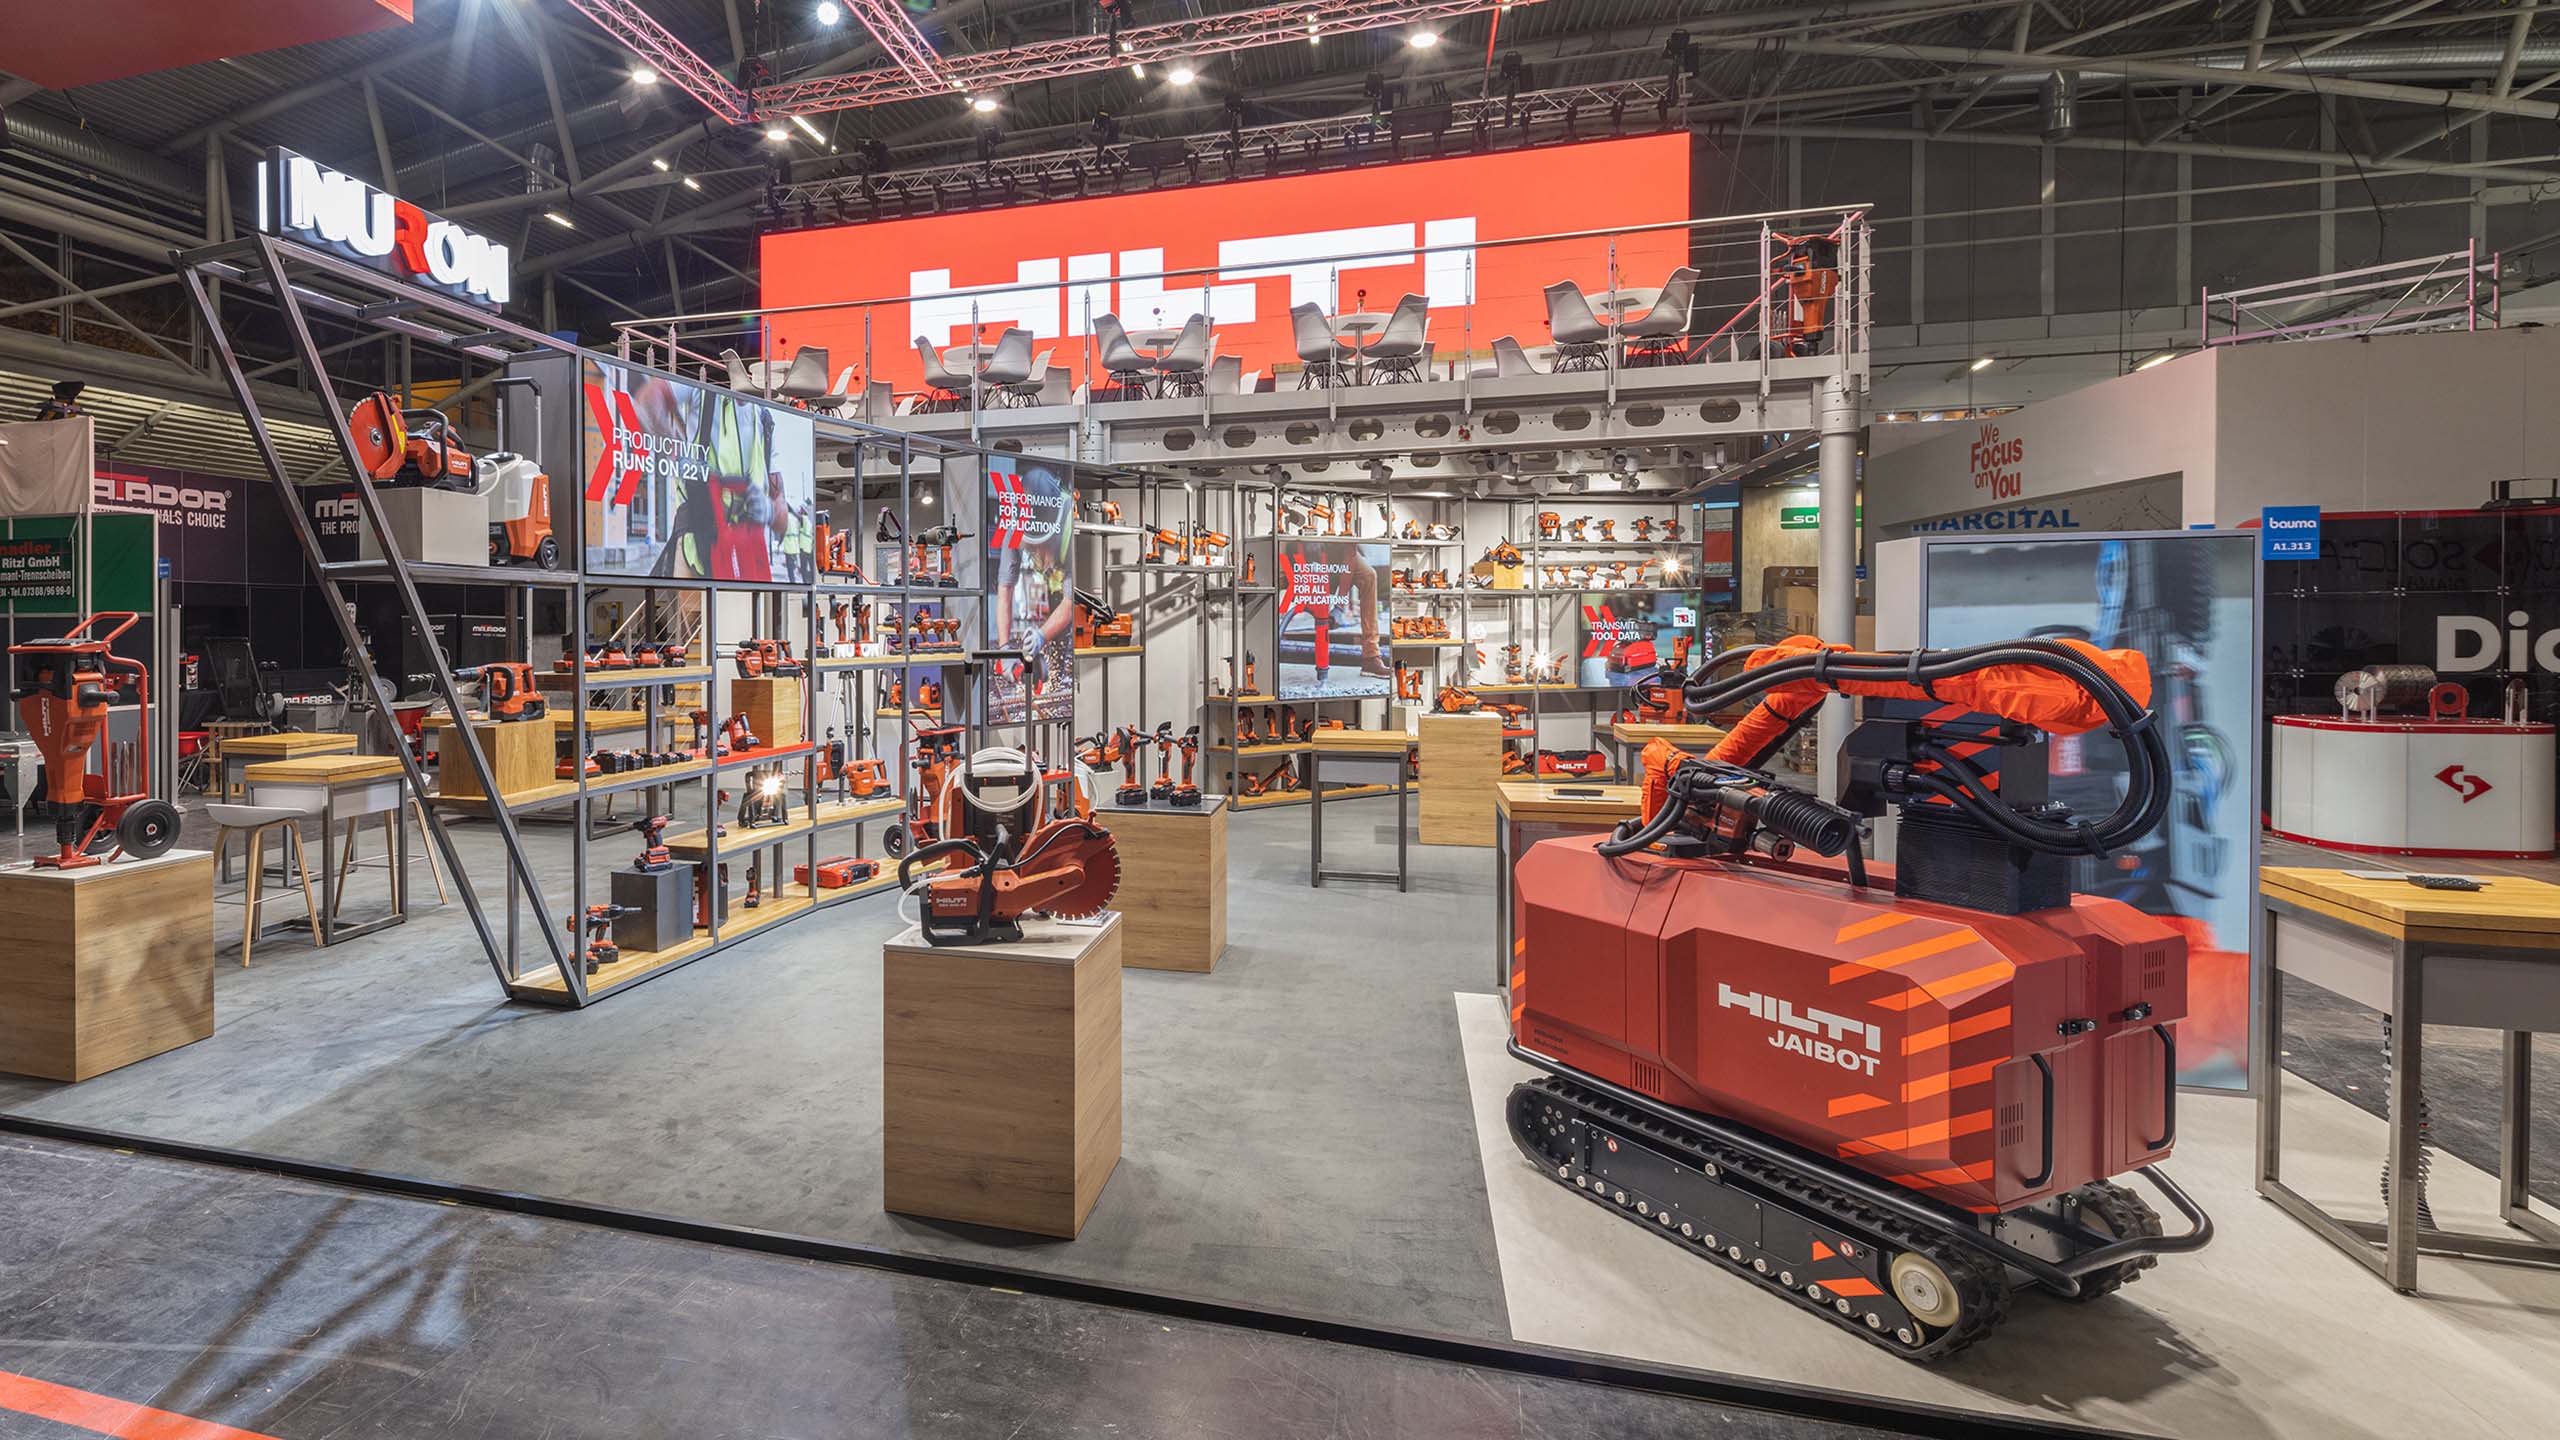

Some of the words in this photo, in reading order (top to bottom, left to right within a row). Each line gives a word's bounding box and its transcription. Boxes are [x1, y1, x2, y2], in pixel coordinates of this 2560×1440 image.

[288, 157, 509, 303] NURON
[910, 216, 1475, 349] HILTI
[1980, 424, 1999, 446] We
[613, 427, 710, 462] PRODUCTIVITY
[1970, 438, 2023, 474] Focus
[612, 450, 655, 474] RUNS
[658, 458, 679, 477] ON
[683, 463, 698, 480] 22
[701, 465, 710, 482] V
[95, 472, 227, 511] ATADOR
[1975, 470, 1988, 489] on
[1988, 468, 2021, 500] You
[999, 491, 1062, 508] PERFORMANCE
[999, 505, 1017, 517] FOR
[1020, 507, 1036, 518] ALL
[187, 512, 226, 528] CHOICE
[320, 521, 337, 535] THE
[999, 518, 1061, 534] APPLICATIONS
[2269, 517, 2317, 529] bauma
[2272, 542, 2312, 551] A1.313
[2, 557, 25, 568] Ritzl
[28, 555, 60, 567] GmbH
[1293, 563, 1313, 573] DUST
[1317, 564, 1351, 574] REMOVAL
[1293, 574, 1329, 583] SYSTEMS
[1294, 585, 1310, 594] FOR
[1312, 585, 1326, 594] ALL
[1294, 595, 1349, 605] APPLICATIONS
[1591, 621, 1635, 631] TRANSMIT
[1591, 631, 1616, 641] TOOL
[1618, 631, 1641, 641] DATA
[1718, 982, 1881, 1053] HILTI
[1768, 1029, 1881, 1077] JAIBOT
